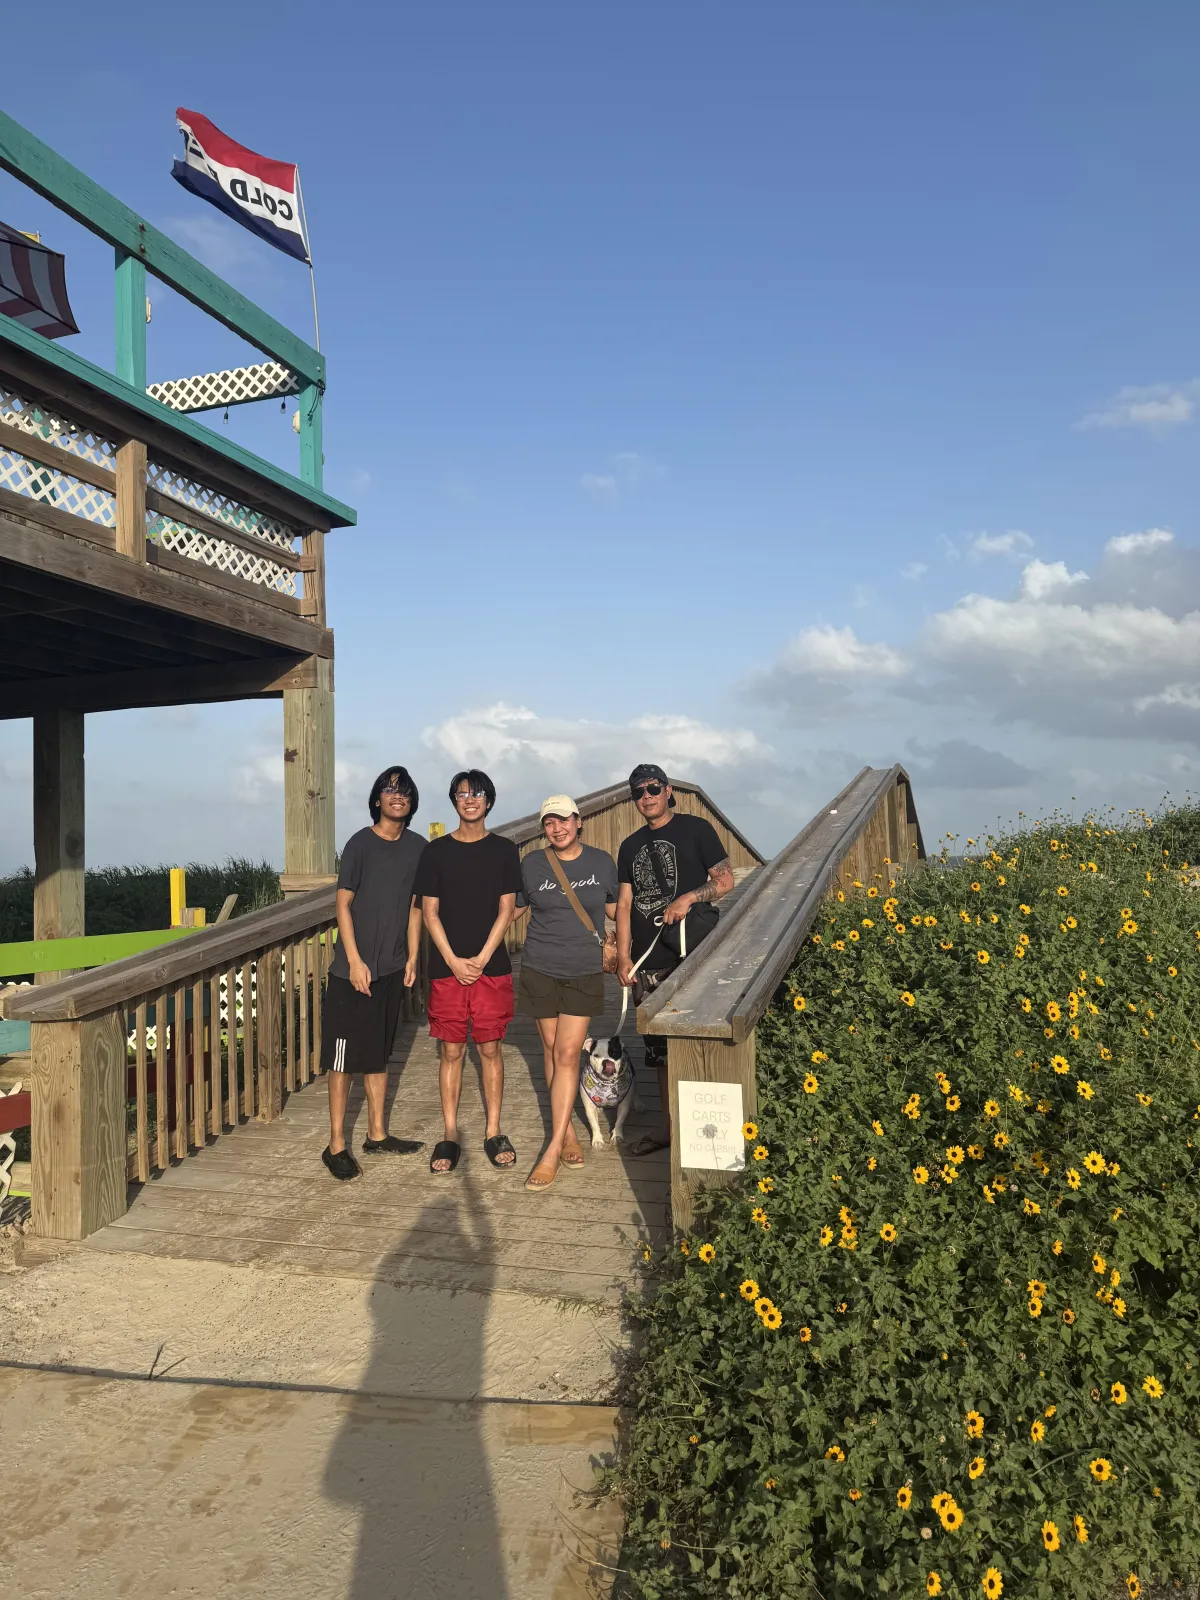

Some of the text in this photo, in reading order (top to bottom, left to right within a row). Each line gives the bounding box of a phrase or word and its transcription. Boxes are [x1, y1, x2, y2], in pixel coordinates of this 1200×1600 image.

[539, 873, 600, 895] do ood.
[694, 1092, 727, 1105] GOLF
[692, 1109, 731, 1123] CARTS
[696, 1127, 728, 1140] ONLY
[689, 1143, 703, 1152] NO
